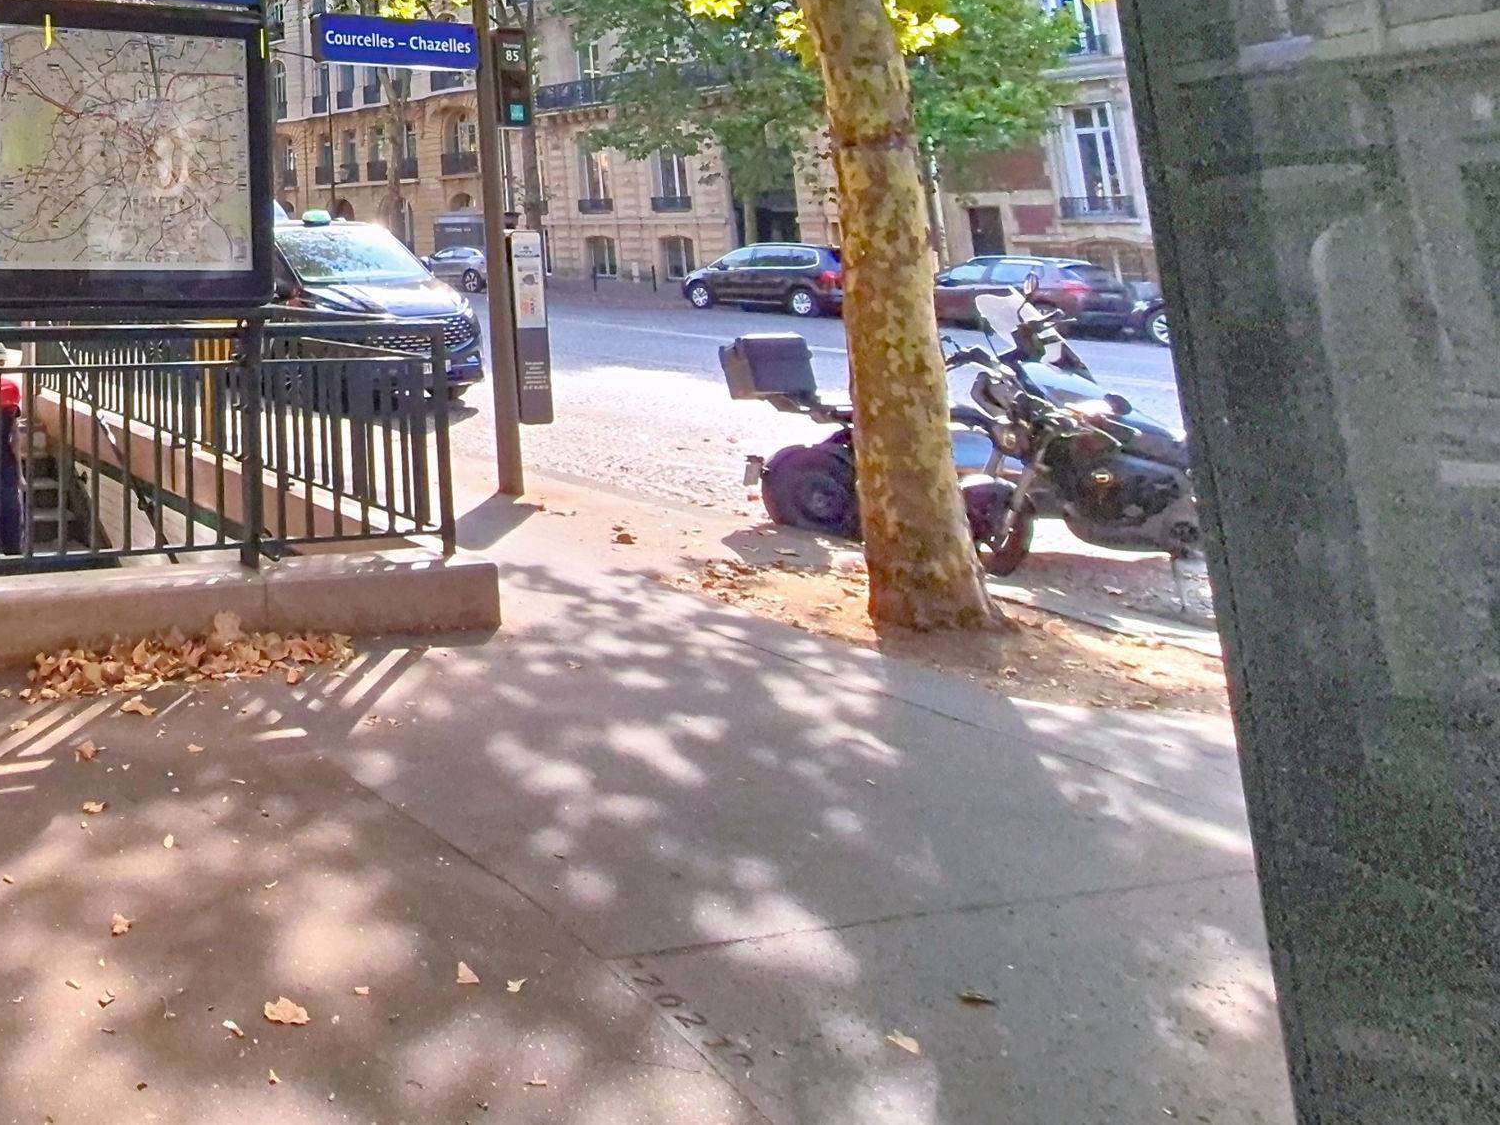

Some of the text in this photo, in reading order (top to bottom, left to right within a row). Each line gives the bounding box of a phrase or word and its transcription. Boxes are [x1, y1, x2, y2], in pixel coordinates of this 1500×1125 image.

[325, 30, 395, 49] Courcelles
[409, 36, 472, 54] Chazelles
[505, 50, 519, 62] 85
